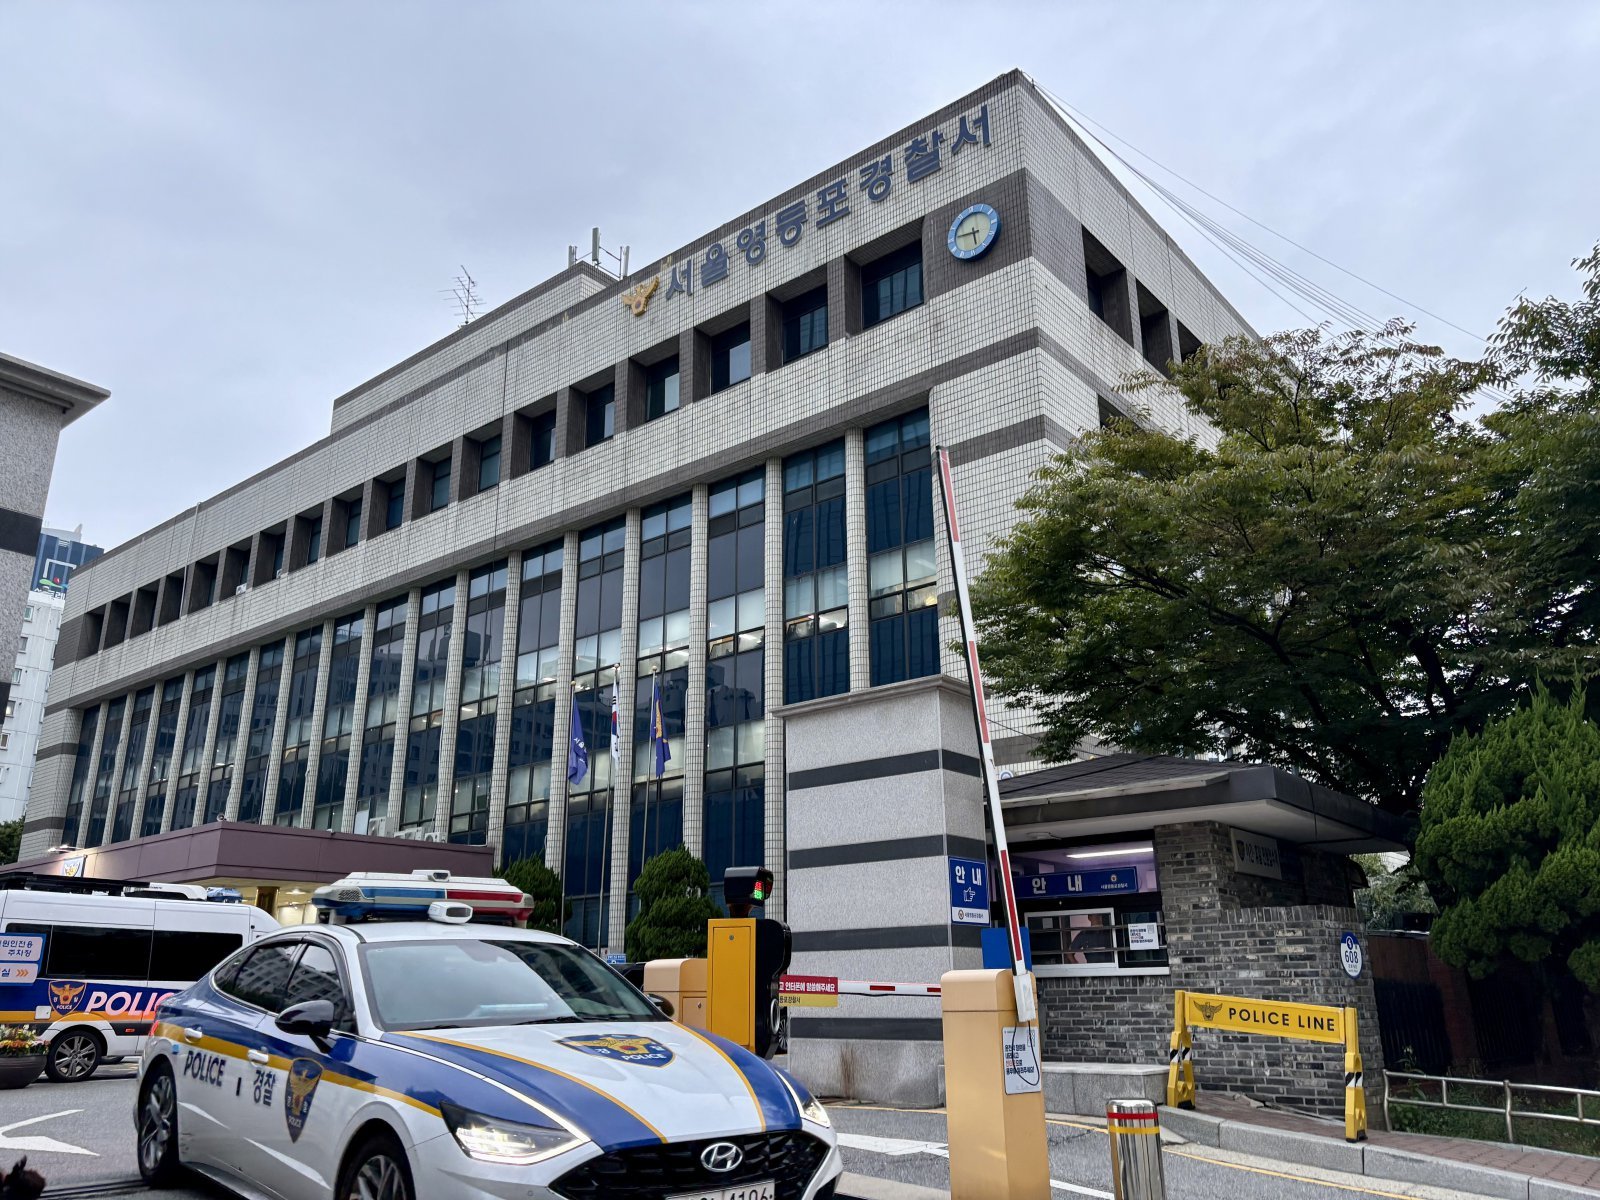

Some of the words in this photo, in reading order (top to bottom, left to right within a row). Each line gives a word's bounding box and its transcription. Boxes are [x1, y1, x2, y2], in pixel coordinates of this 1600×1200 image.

[666, 104, 993, 301] 서울영등포경찰서
[0, 939, 33, 949] 원인전용
[1344, 950, 1359, 964] 608
[1229, 1007, 1290, 1026] POLICE
[1298, 1015, 1335, 1032] LINE
[183, 1050, 227, 1088] POLICE
[253, 1069, 276, 1107] 경찰
